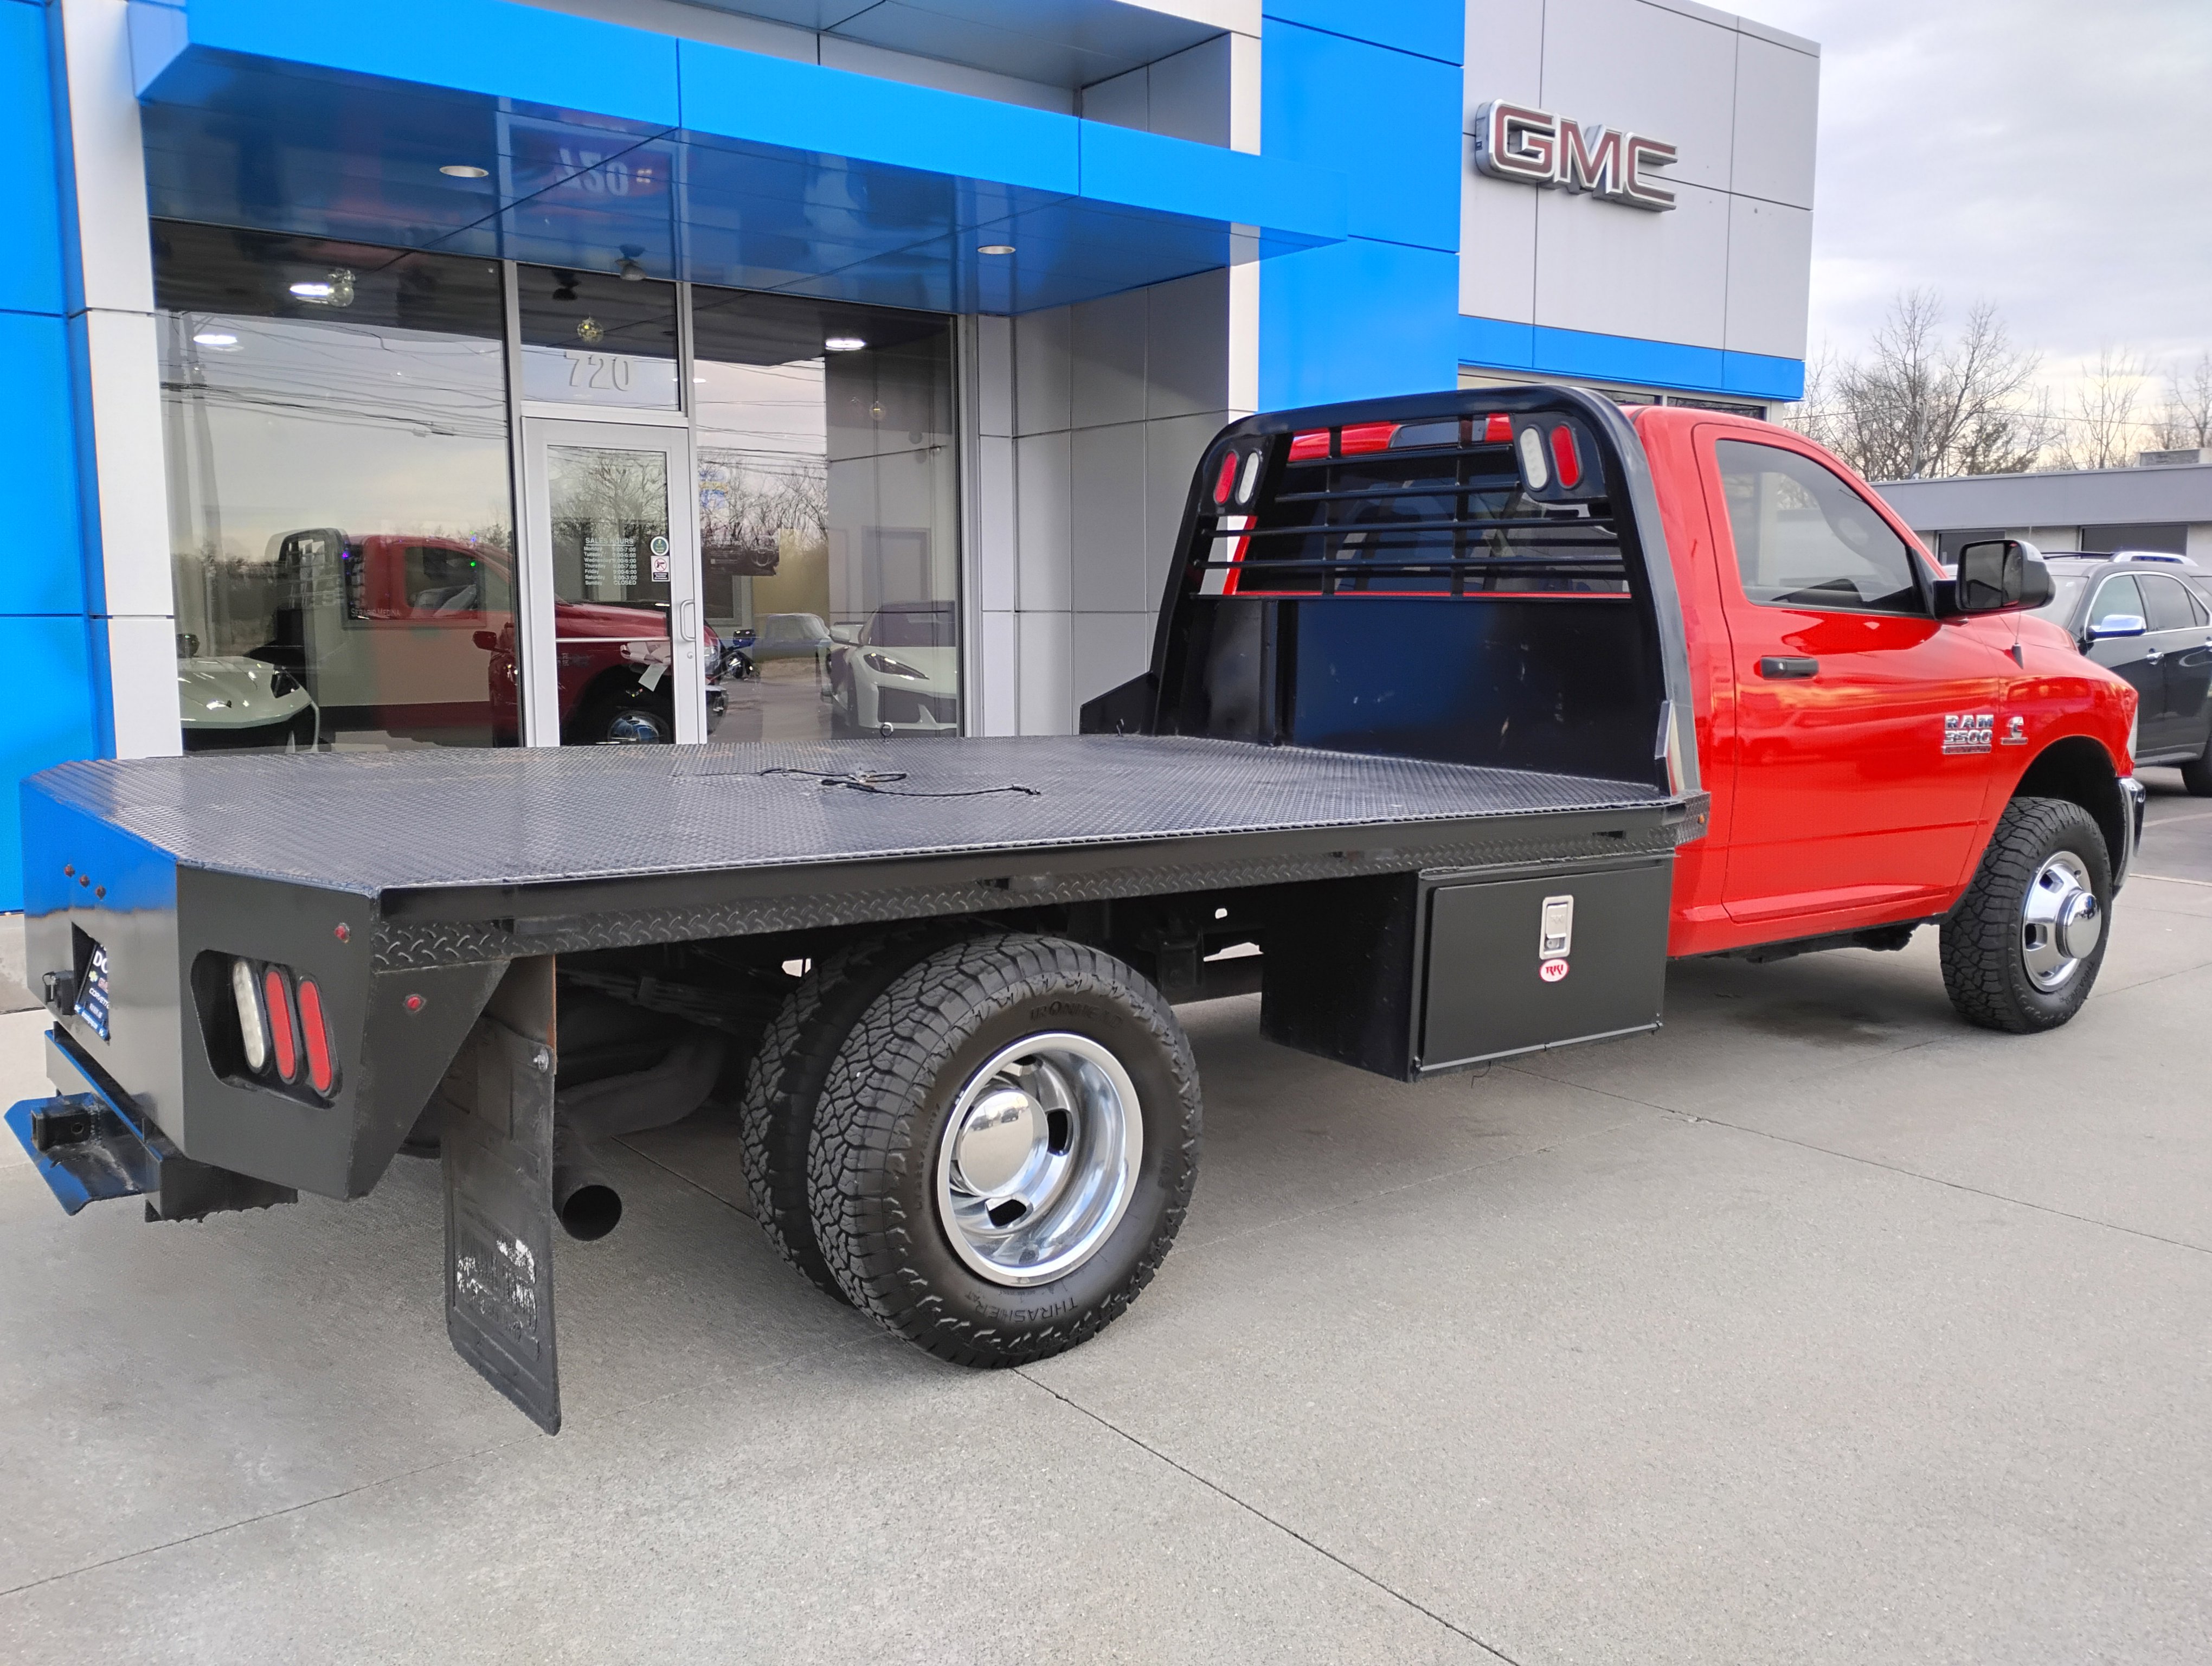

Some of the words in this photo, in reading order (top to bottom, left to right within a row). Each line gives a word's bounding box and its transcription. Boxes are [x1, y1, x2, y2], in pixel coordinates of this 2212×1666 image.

[1481, 99, 1678, 210] GMC
[564, 350, 635, 392] 720
[1945, 714, 1994, 729] RAM
[1943, 729, 1993, 745] 3500
[1545, 964, 1564, 976] RKI
[1029, 1001, 1124, 1029] IRONHEAD
[975, 1297, 1078, 1323] THRASHER
